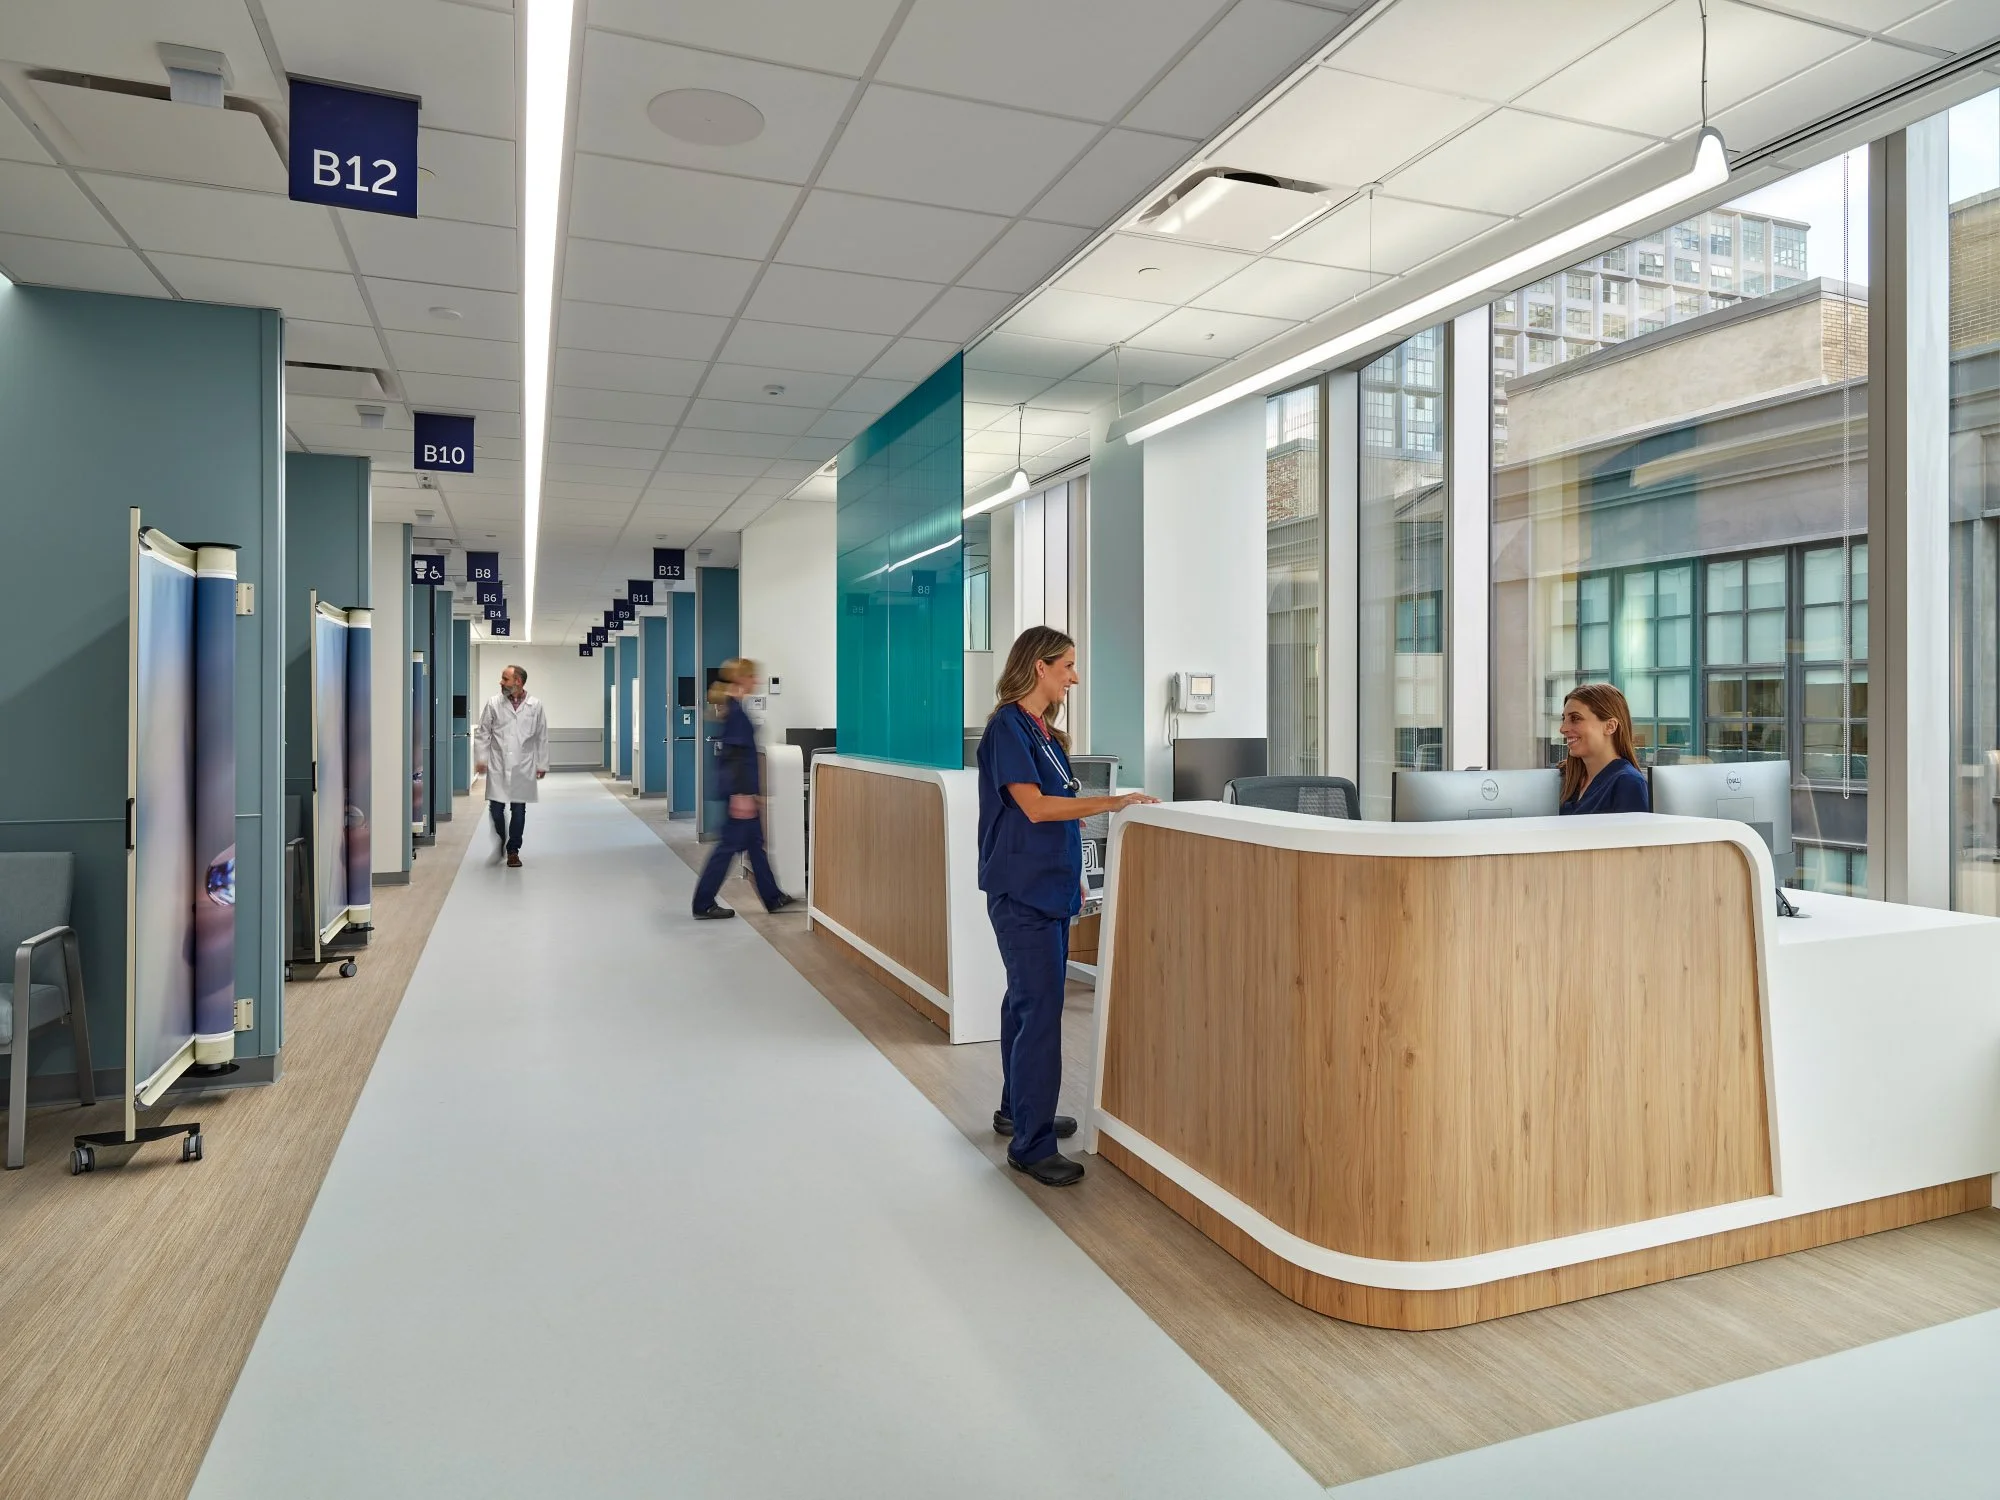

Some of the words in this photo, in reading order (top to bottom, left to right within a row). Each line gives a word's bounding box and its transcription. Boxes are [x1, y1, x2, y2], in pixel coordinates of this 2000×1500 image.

[313, 149, 398, 196] B12
[424, 444, 465, 465] B10
[475, 568, 491, 579] B8
[659, 565, 680, 576] B13
[483, 593, 497, 603] B6
[632, 594, 649, 603] B11
[490, 610, 501, 618] B4
[618, 610, 630, 619] B9
[609, 621, 619, 629] B7
